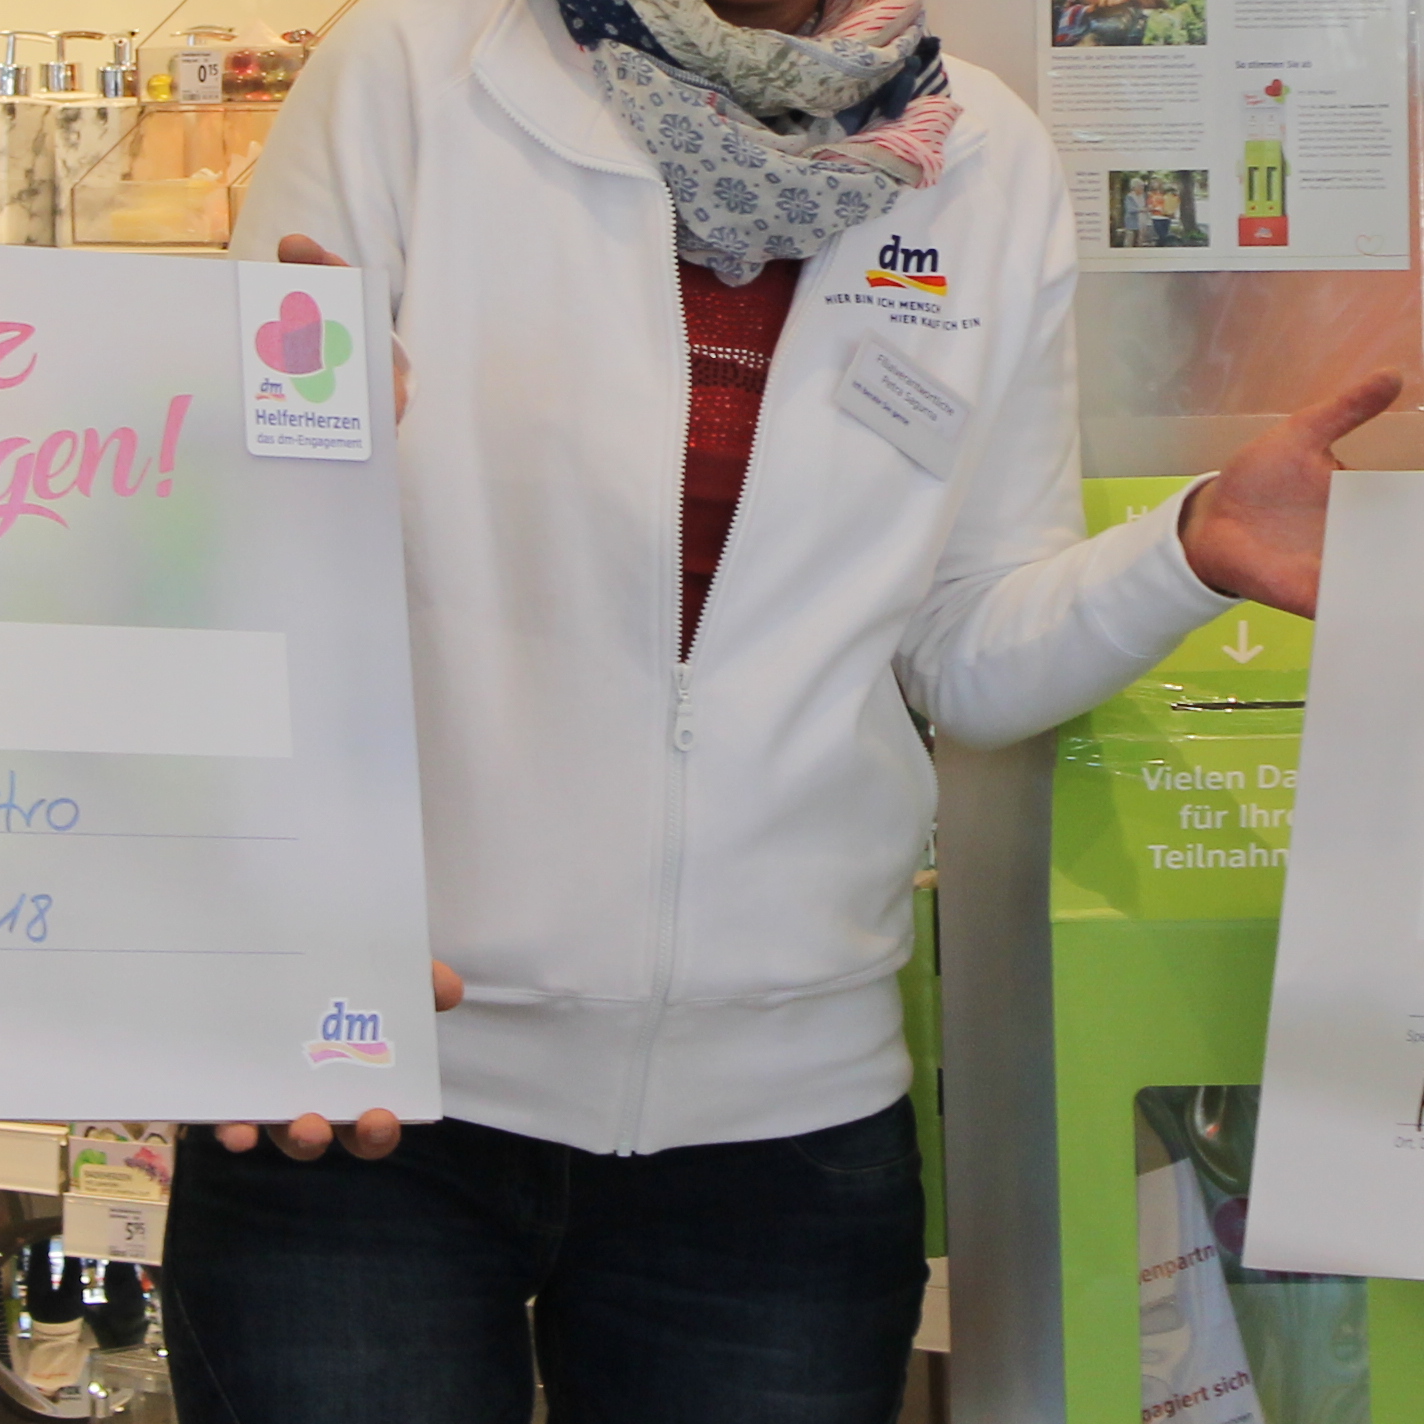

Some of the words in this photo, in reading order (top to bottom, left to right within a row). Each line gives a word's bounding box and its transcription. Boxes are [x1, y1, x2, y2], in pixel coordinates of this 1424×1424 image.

[879, 234, 939, 273] dm
[824, 293, 851, 305] HIER
[855, 294, 874, 305] BIN
[877, 297, 895, 309] ICH
[890, 314, 918, 325] HIER
[962, 317, 981, 329] EIN
[255, 409, 361, 430] HelferHerzen
[257, 433, 275, 444] das
[277, 434, 363, 449] dm-Engagement
[1142, 764, 1246, 791] Vielen
[1179, 805, 1229, 830] für
[321, 1001, 380, 1043] dm
[1213, 1370, 1251, 1398] sich
